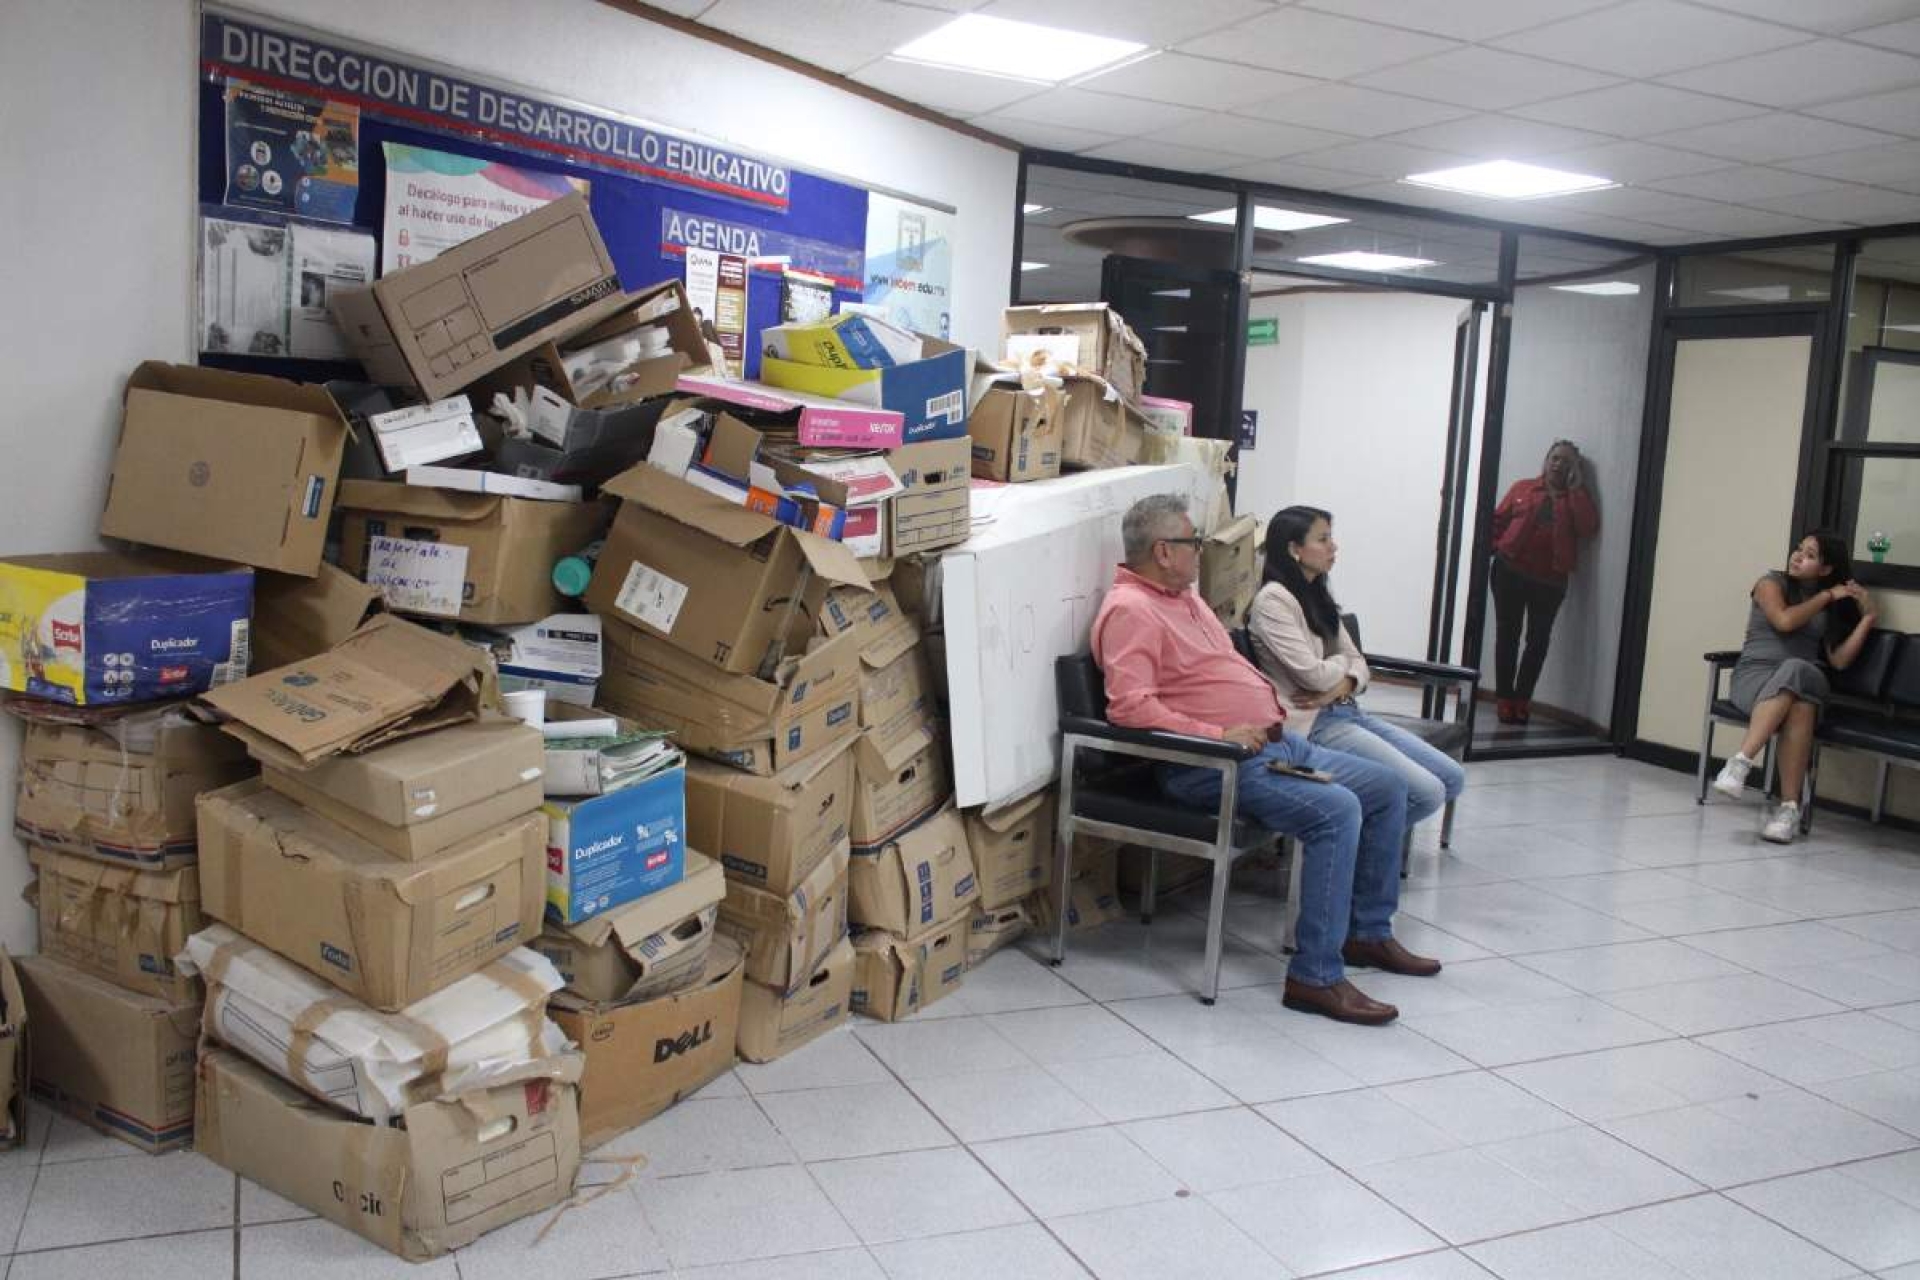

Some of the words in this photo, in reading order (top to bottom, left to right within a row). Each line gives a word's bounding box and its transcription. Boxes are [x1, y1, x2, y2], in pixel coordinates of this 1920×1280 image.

[223, 24, 419, 106] DIRECCION
[430, 79, 470, 118] DE
[478, 100, 659, 162] DESARROLLO
[666, 141, 787, 195] EDUCATIVO
[397, 204, 409, 216] al
[412, 206, 443, 222] hacer
[446, 213, 466, 225] uso
[469, 214, 482, 227] de
[667, 214, 761, 256] AGENDA
[151, 637, 199, 652] Duplicador
[575, 834, 623, 860] Duplicador
[653, 1019, 713, 1064] DELL
